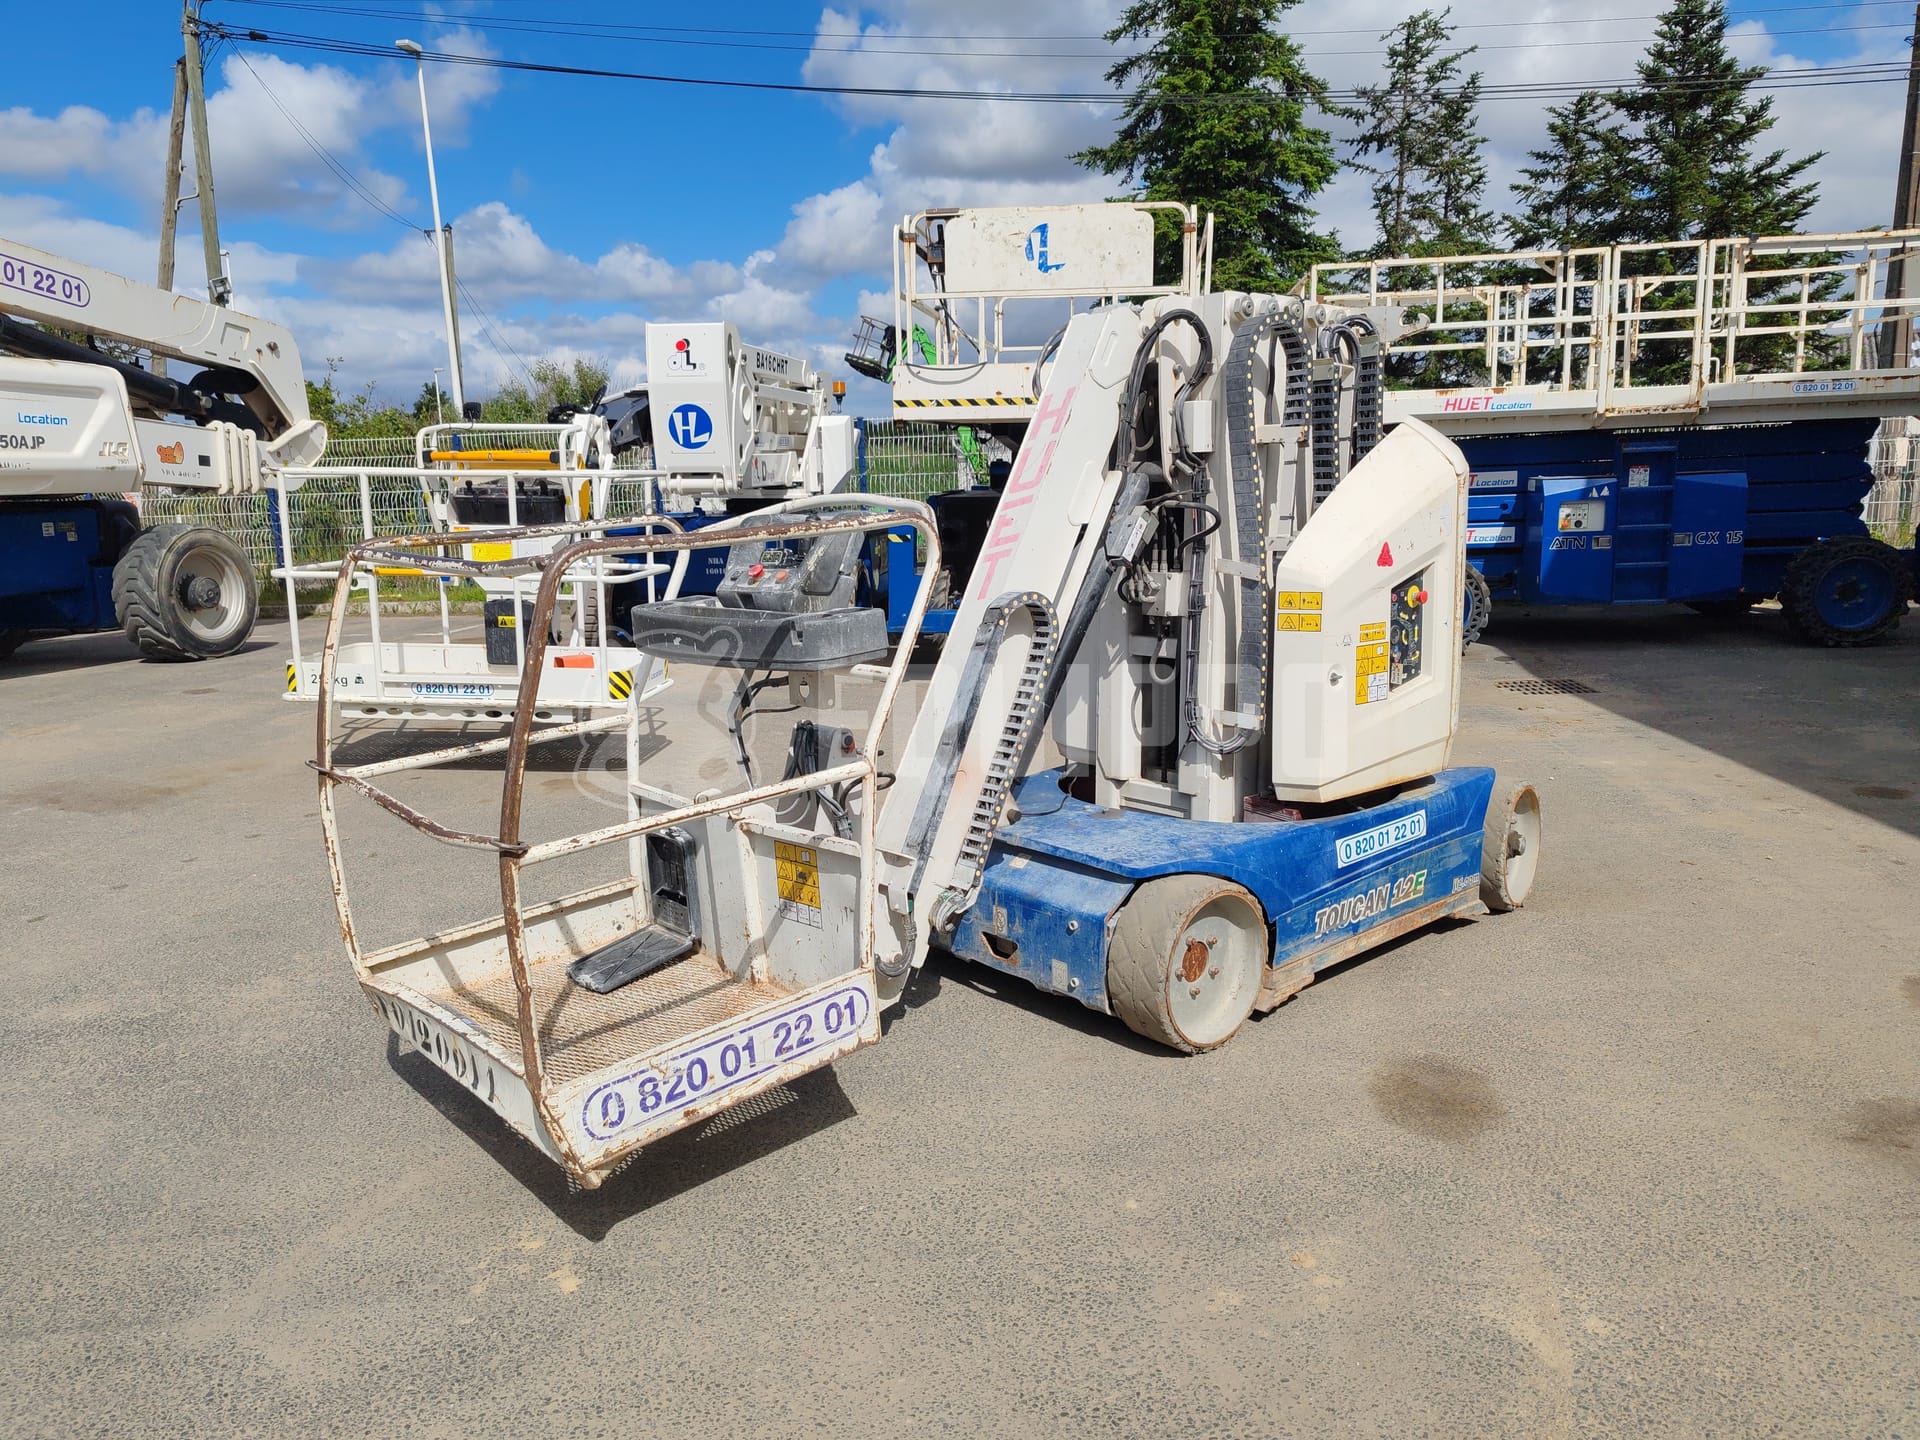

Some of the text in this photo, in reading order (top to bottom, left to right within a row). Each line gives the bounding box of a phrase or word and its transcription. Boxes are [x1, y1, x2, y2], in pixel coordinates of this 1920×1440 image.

[3, 260, 82, 303] 01 22 01
[1795, 381, 1854, 392] 0 820 01 22 01
[1443, 396, 1532, 412] HUET Location
[17, 412, 68, 426] Location
[1476, 478, 1515, 487] Location
[977, 386, 1077, 601] HUET
[1473, 534, 1513, 543] Location
[1549, 536, 1587, 550] ATN
[1695, 530, 1744, 545] CX 15
[416, 683, 491, 694] 0 820 01 22 01
[1345, 817, 1422, 860] 0 820 01 22 01
[1314, 869, 1428, 939] TOUCAN 12E
[600, 994, 857, 1129] 0 820 01 22 01
